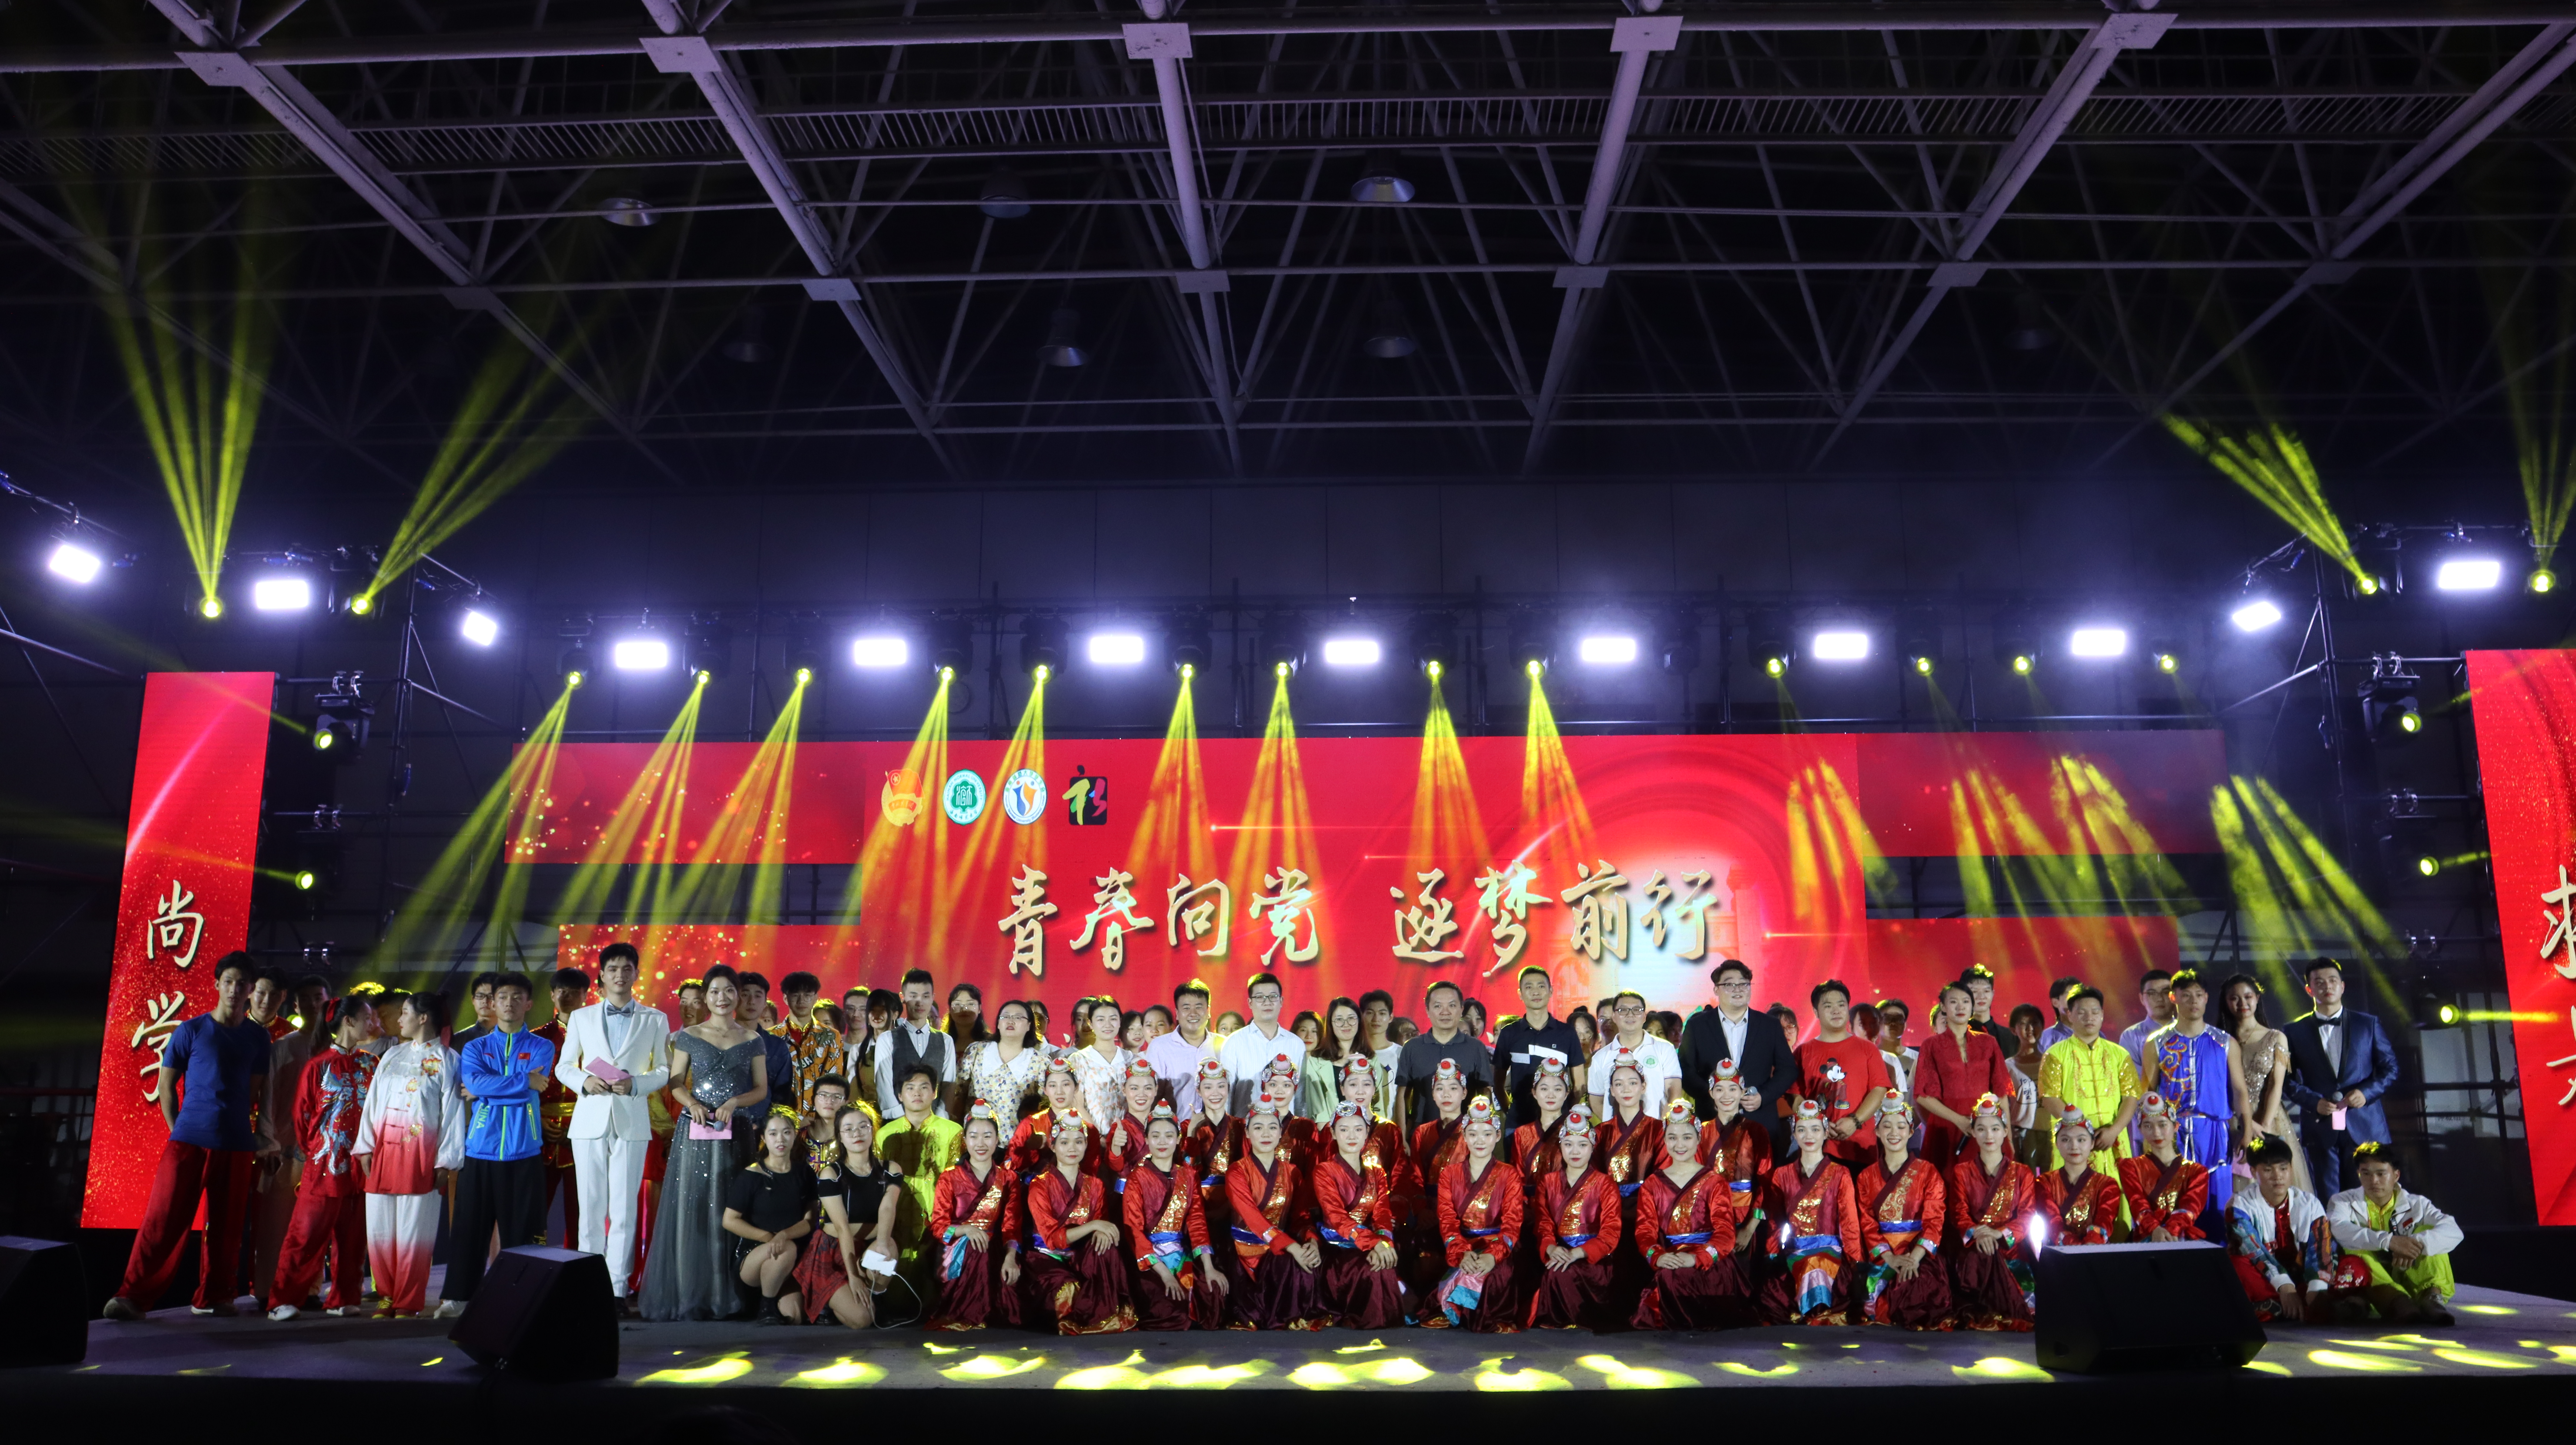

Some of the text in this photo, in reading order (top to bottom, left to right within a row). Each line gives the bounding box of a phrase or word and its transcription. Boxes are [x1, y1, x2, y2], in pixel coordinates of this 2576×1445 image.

[954, 774, 970, 782] NORMAL
[971, 776, 983, 800] UNIVERSITY
[997, 859, 1717, 977] 青春向党 逐梦前行
[131, 879, 204, 1102] 尚学
[476, 1105, 490, 1129] HINA
